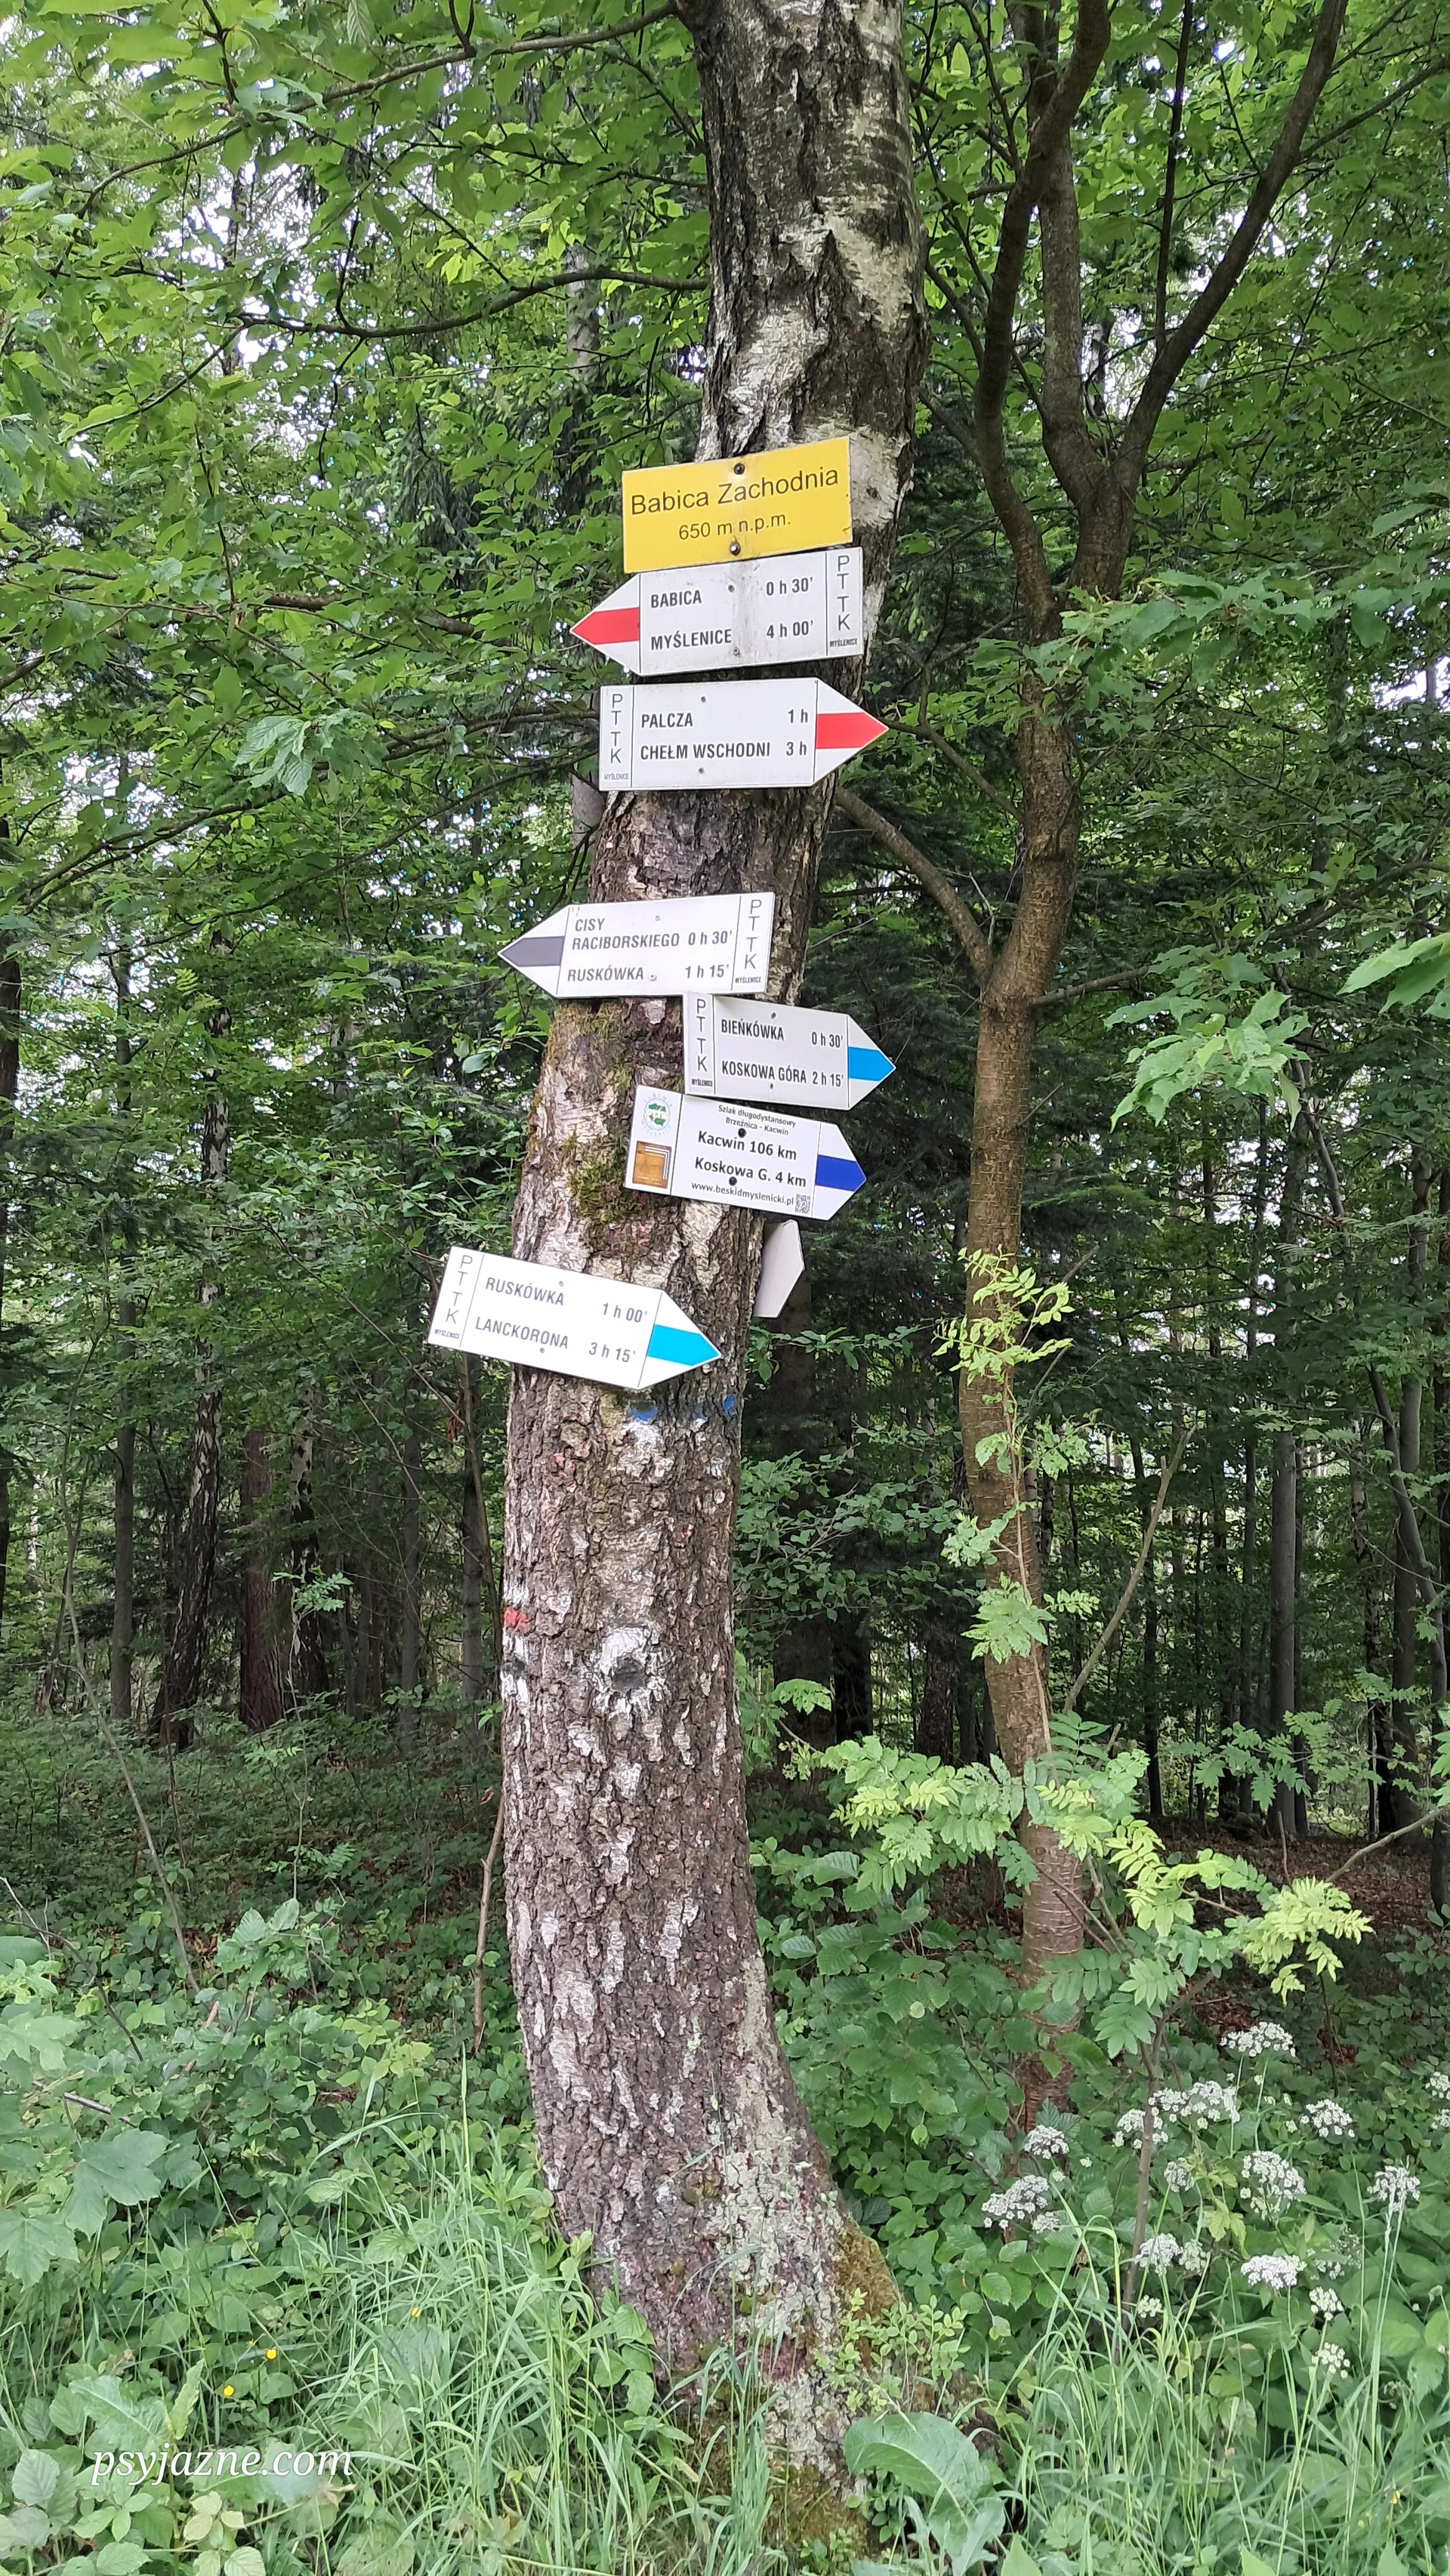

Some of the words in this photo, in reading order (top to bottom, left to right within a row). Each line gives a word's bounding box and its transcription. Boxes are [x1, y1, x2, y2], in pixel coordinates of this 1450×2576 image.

[631, 489, 708, 515] Babica
[717, 467, 838, 505] Zachodnia
[679, 522, 710, 540] 650
[717, 522, 732, 535] m
[739, 513, 791, 535] n.p.m.
[651, 590, 702, 609] BABICA
[767, 582, 774, 596] 0
[779, 580, 786, 594] h
[651, 628, 732, 650] MYŚLENICE
[767, 626, 774, 639] 4
[780, 624, 787, 637] h
[641, 713, 693, 729] PALCZA
[788, 710, 793, 723] 1
[801, 709, 808, 723] h
[641, 744, 687, 760] CHEŁM
[693, 742, 770, 759] WSCHODNI
[786, 741, 793, 756] 3
[800, 741, 807, 755] h
[575, 918, 605, 931] CISY
[572, 933, 680, 950] RACIBORSKIEGO
[688, 933, 696, 945] 0
[700, 932, 707, 944] h
[568, 966, 643, 981] RUSKÓWKA
[685, 966, 690, 978] 1
[697, 966, 704, 978] h
[722, 1018, 784, 1041] BIEŃKÓWKA
[812, 1032, 817, 1045] 0
[821, 1033, 825, 1046] h
[722, 1061, 775, 1080] KOSKOWA
[779, 1065, 807, 1083] GÓRA
[813, 1072, 818, 1084] 2
[822, 1073, 826, 1085] h
[718, 1105, 736, 1114] Szlak
[738, 1109, 796, 1128] długodystansowy
[764, 1125, 788, 1135] Kacwin
[698, 1131, 744, 1151] Kacwin
[750, 1141, 773, 1156] 106
[778, 1145, 797, 1160] km
[695, 1157, 753, 1178] Koskowa
[758, 1169, 770, 1182] G.
[776, 1172, 783, 1184] 4
[788, 1172, 806, 1188] km
[692, 1182, 793, 1206] www.beskidmyslenicki.pl
[486, 1277, 563, 1306] RUSKÓWKA
[603, 1303, 608, 1315] 1
[615, 1305, 622, 1318] h
[476, 1317, 569, 1349] LANCKORONA
[589, 1342, 597, 1355] 3
[602, 1345, 609, 1357] h
